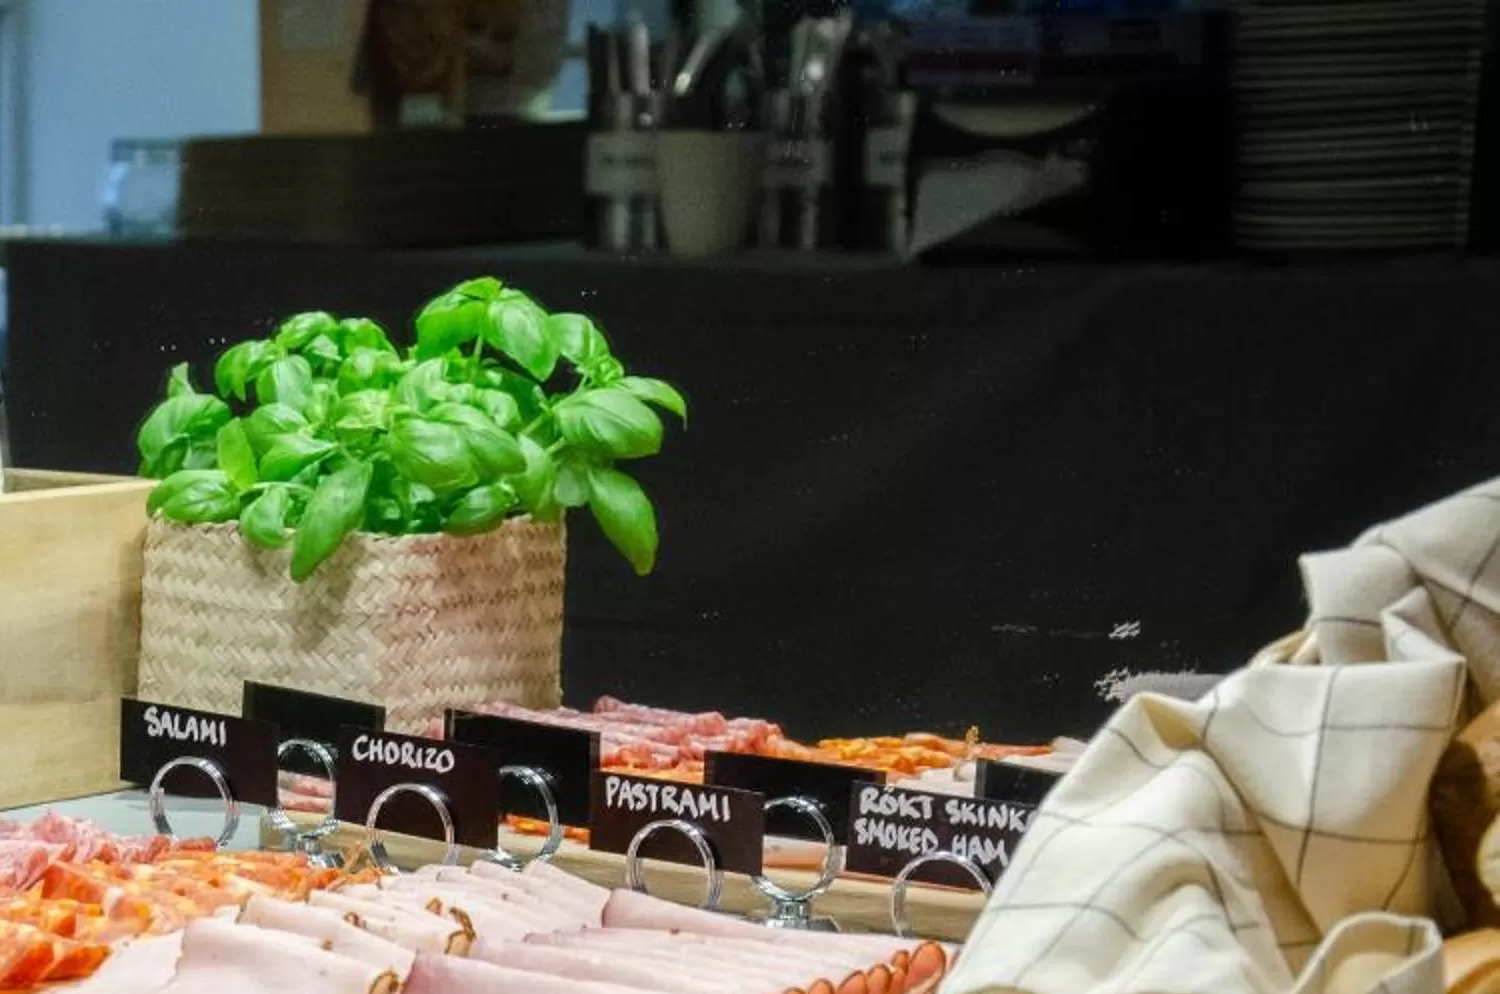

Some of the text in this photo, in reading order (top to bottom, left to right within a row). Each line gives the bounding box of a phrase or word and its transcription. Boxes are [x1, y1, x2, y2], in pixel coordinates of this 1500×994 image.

[143, 706, 227, 747] SALAMI
[352, 734, 456, 774] CHORIZO
[605, 776, 731, 823] PASTRAMI
[853, 817, 1010, 867] SMOKED HAM
